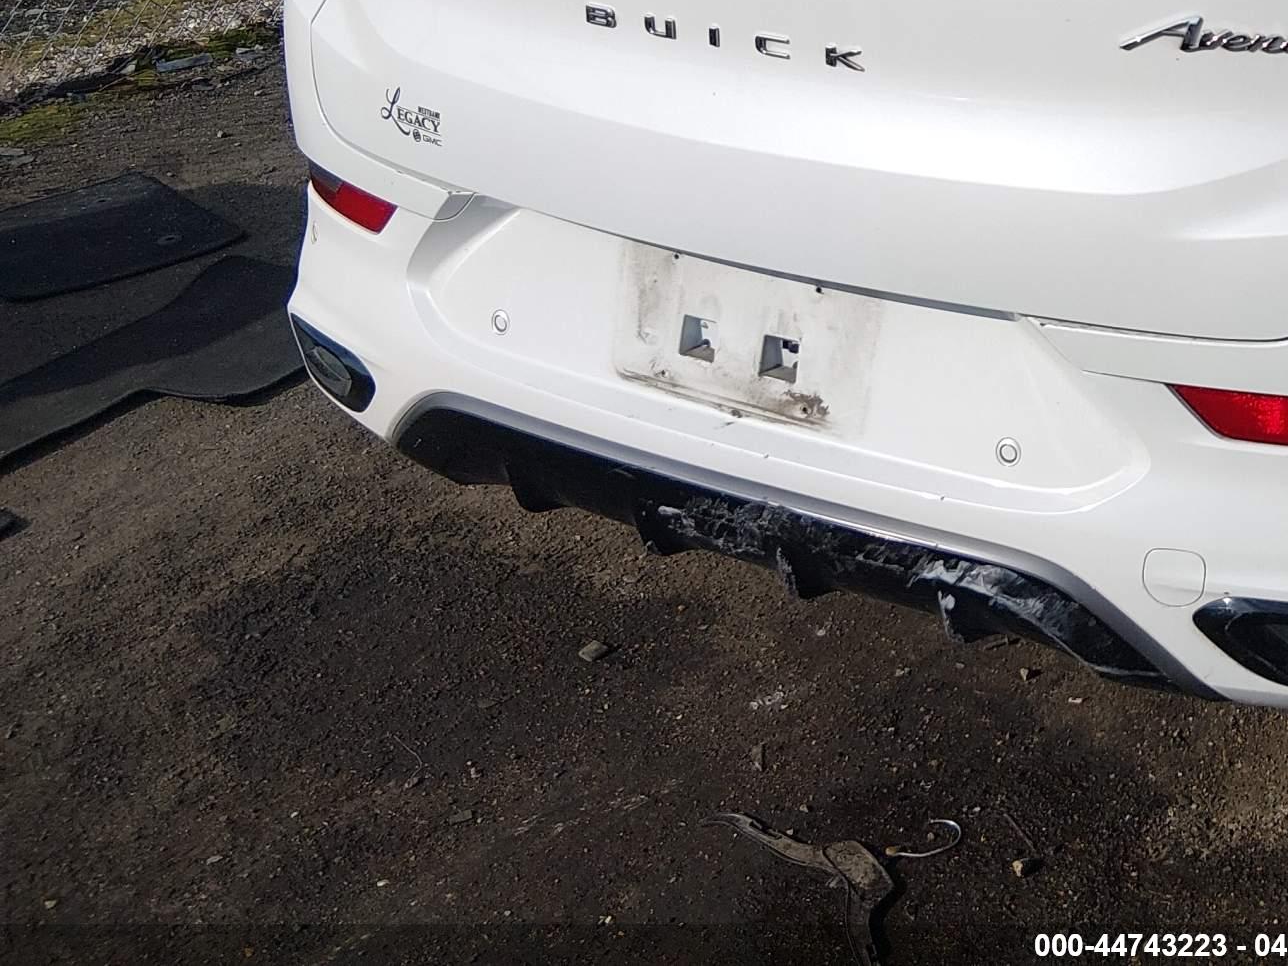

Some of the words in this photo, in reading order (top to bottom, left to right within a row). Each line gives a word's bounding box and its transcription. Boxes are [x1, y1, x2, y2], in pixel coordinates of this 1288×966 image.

[584, 1, 866, 72] BUICK
[380, 86, 441, 137] LEGACY
[422, 134, 443, 147] GMC
